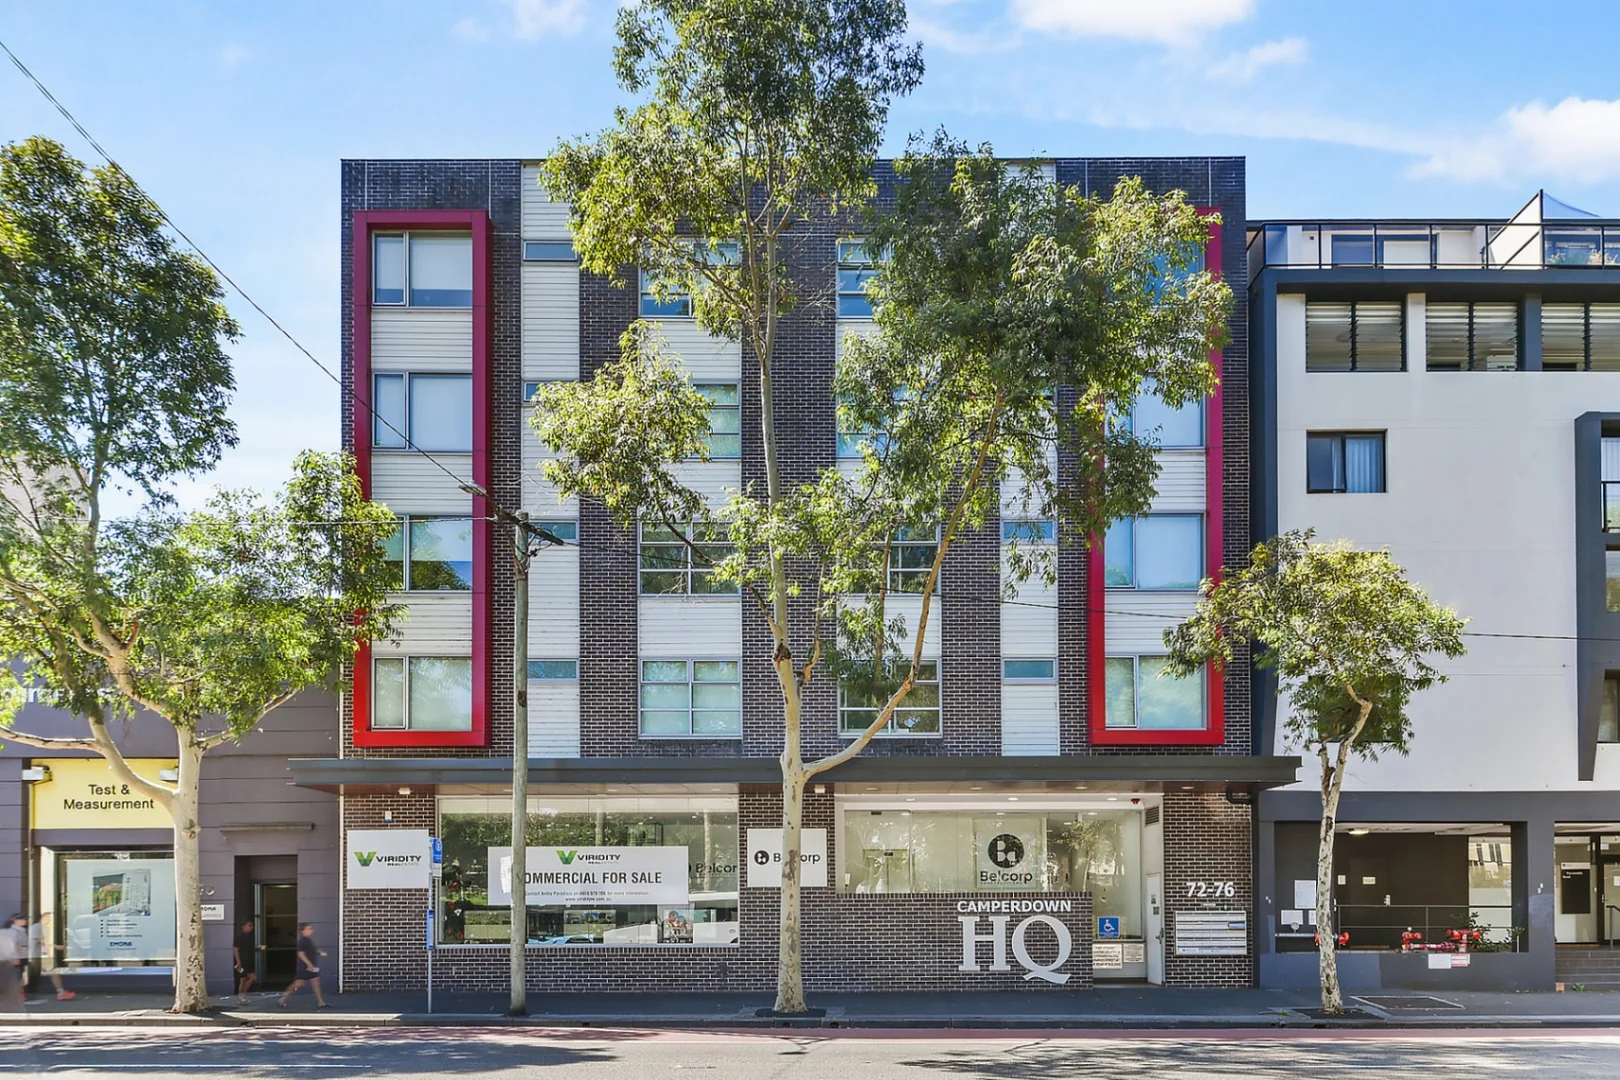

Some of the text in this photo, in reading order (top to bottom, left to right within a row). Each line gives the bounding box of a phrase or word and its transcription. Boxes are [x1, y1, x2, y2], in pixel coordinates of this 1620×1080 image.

[88, 784, 130, 795] Test &
[63, 799, 154, 810] Measurement
[773, 852, 821, 865] Borp
[695, 862, 738, 874] Belcor
[525, 872, 662, 884] OMMERCIAL FOR SALE
[980, 870, 1033, 884] Belcorp
[1186, 881, 1235, 897] 72-76
[957, 900, 1072, 913] CAMPERDOWN
[957, 914, 1072, 984] HQ
